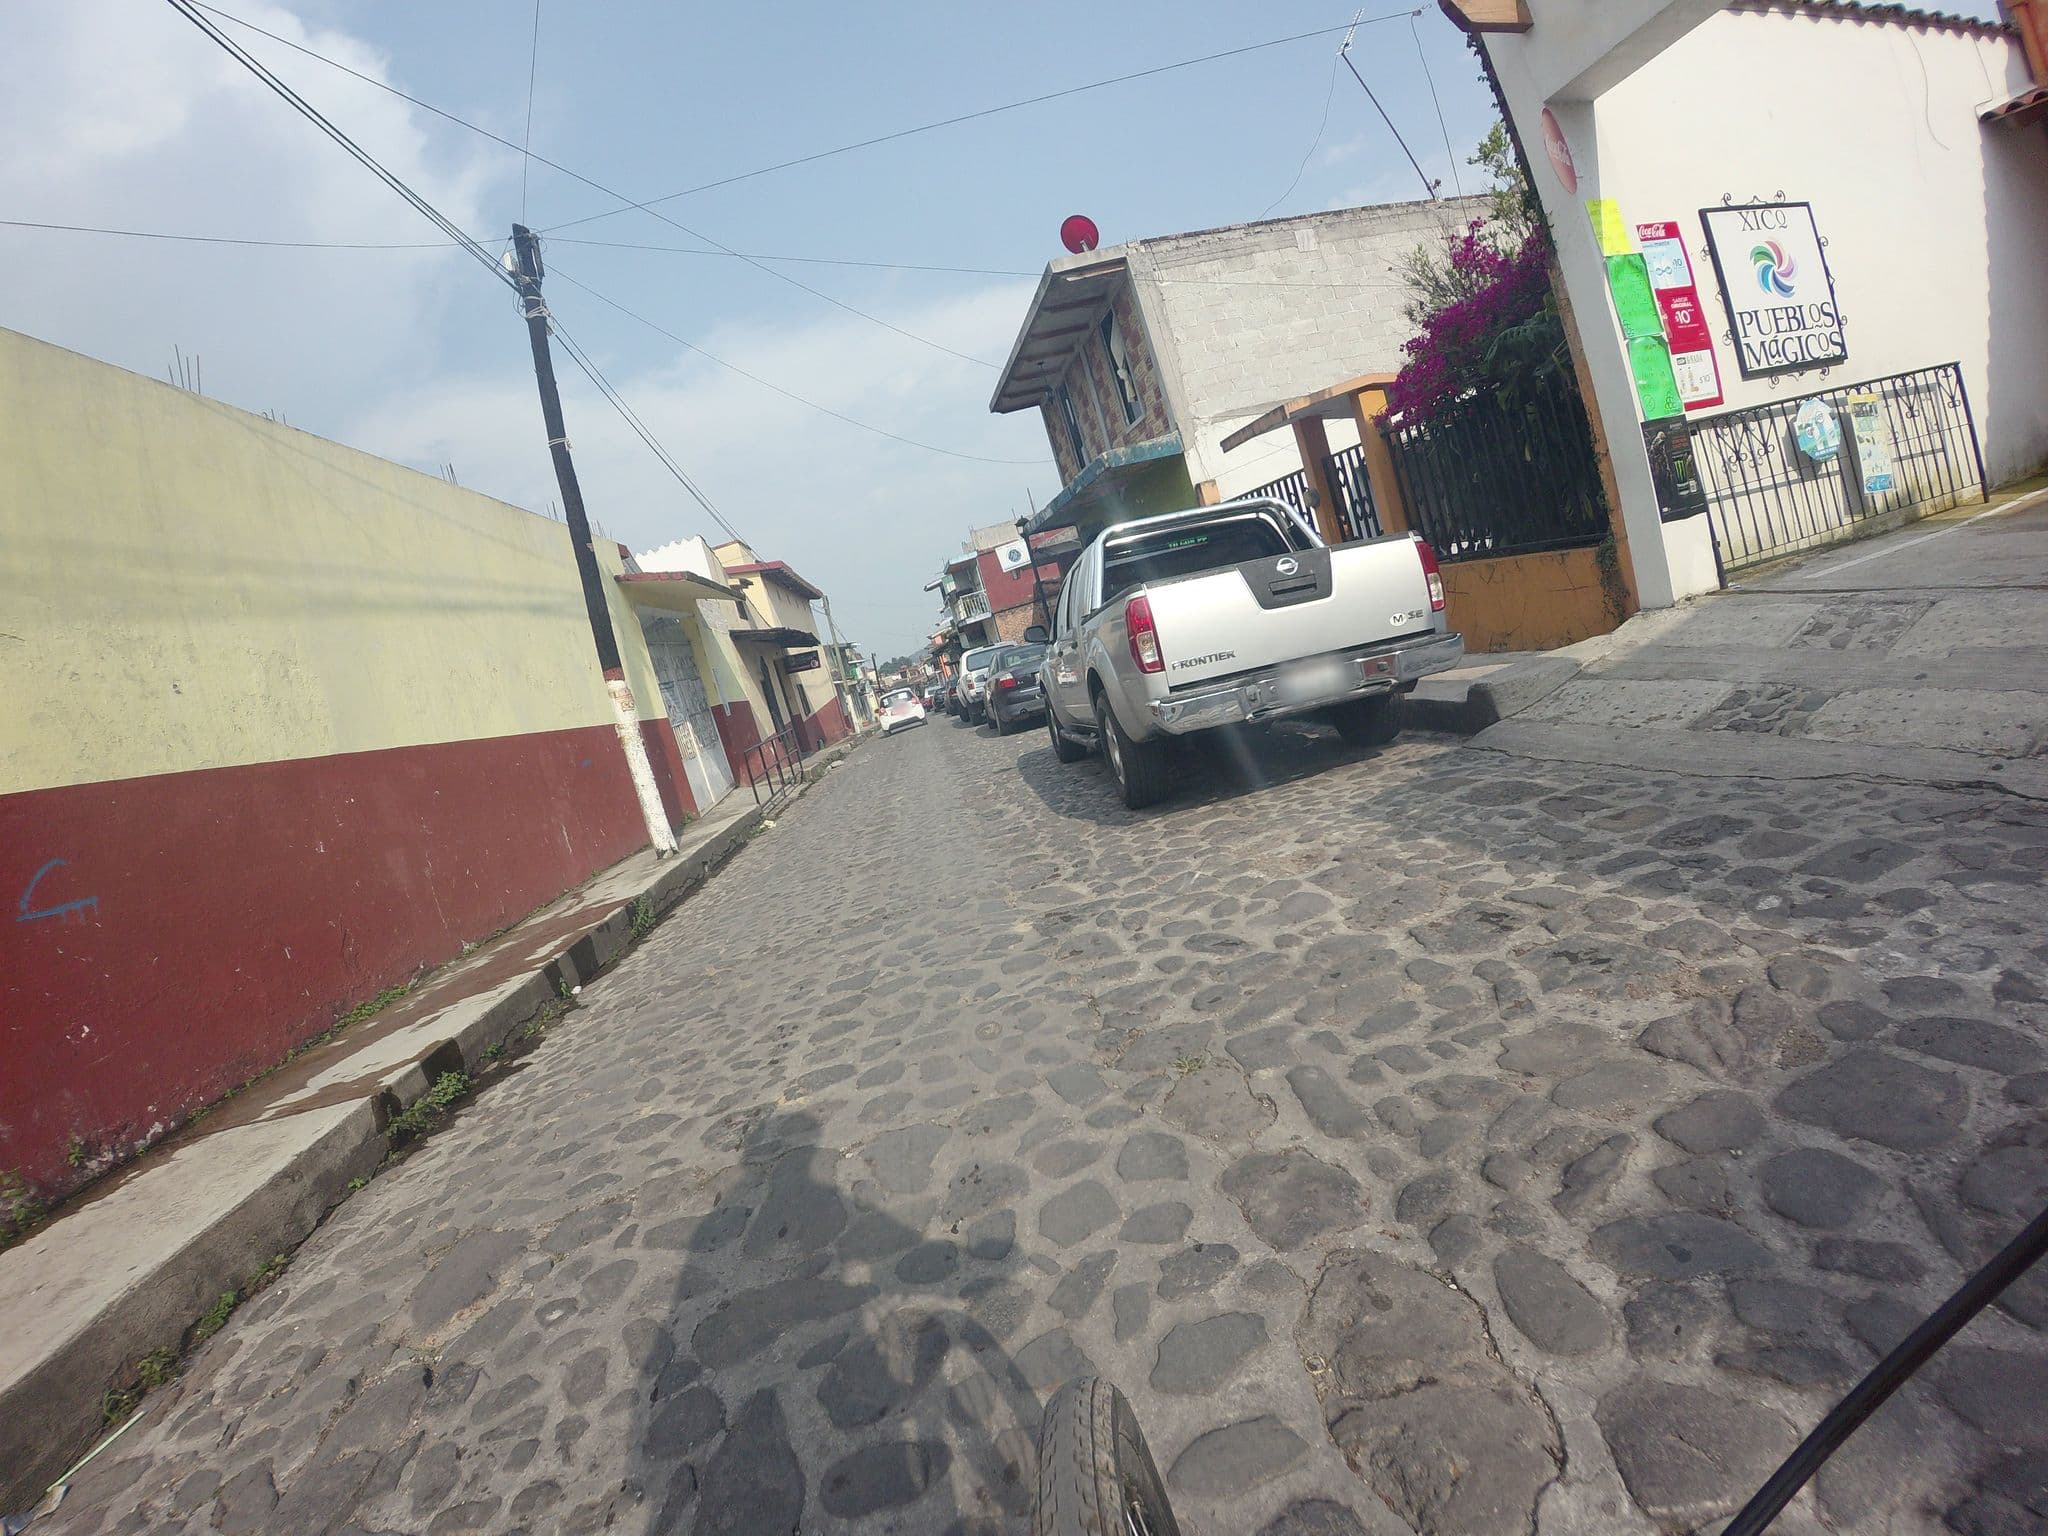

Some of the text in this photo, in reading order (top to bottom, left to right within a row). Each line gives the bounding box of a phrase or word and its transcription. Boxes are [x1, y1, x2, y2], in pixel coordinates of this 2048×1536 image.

[1737, 209, 1788, 232] XICO
[1736, 301, 1836, 339] PUEBLOS
[1392, 613, 1404, 624] M
[1407, 609, 1424, 620] SE
[1171, 650, 1237, 671] FRONTIER
